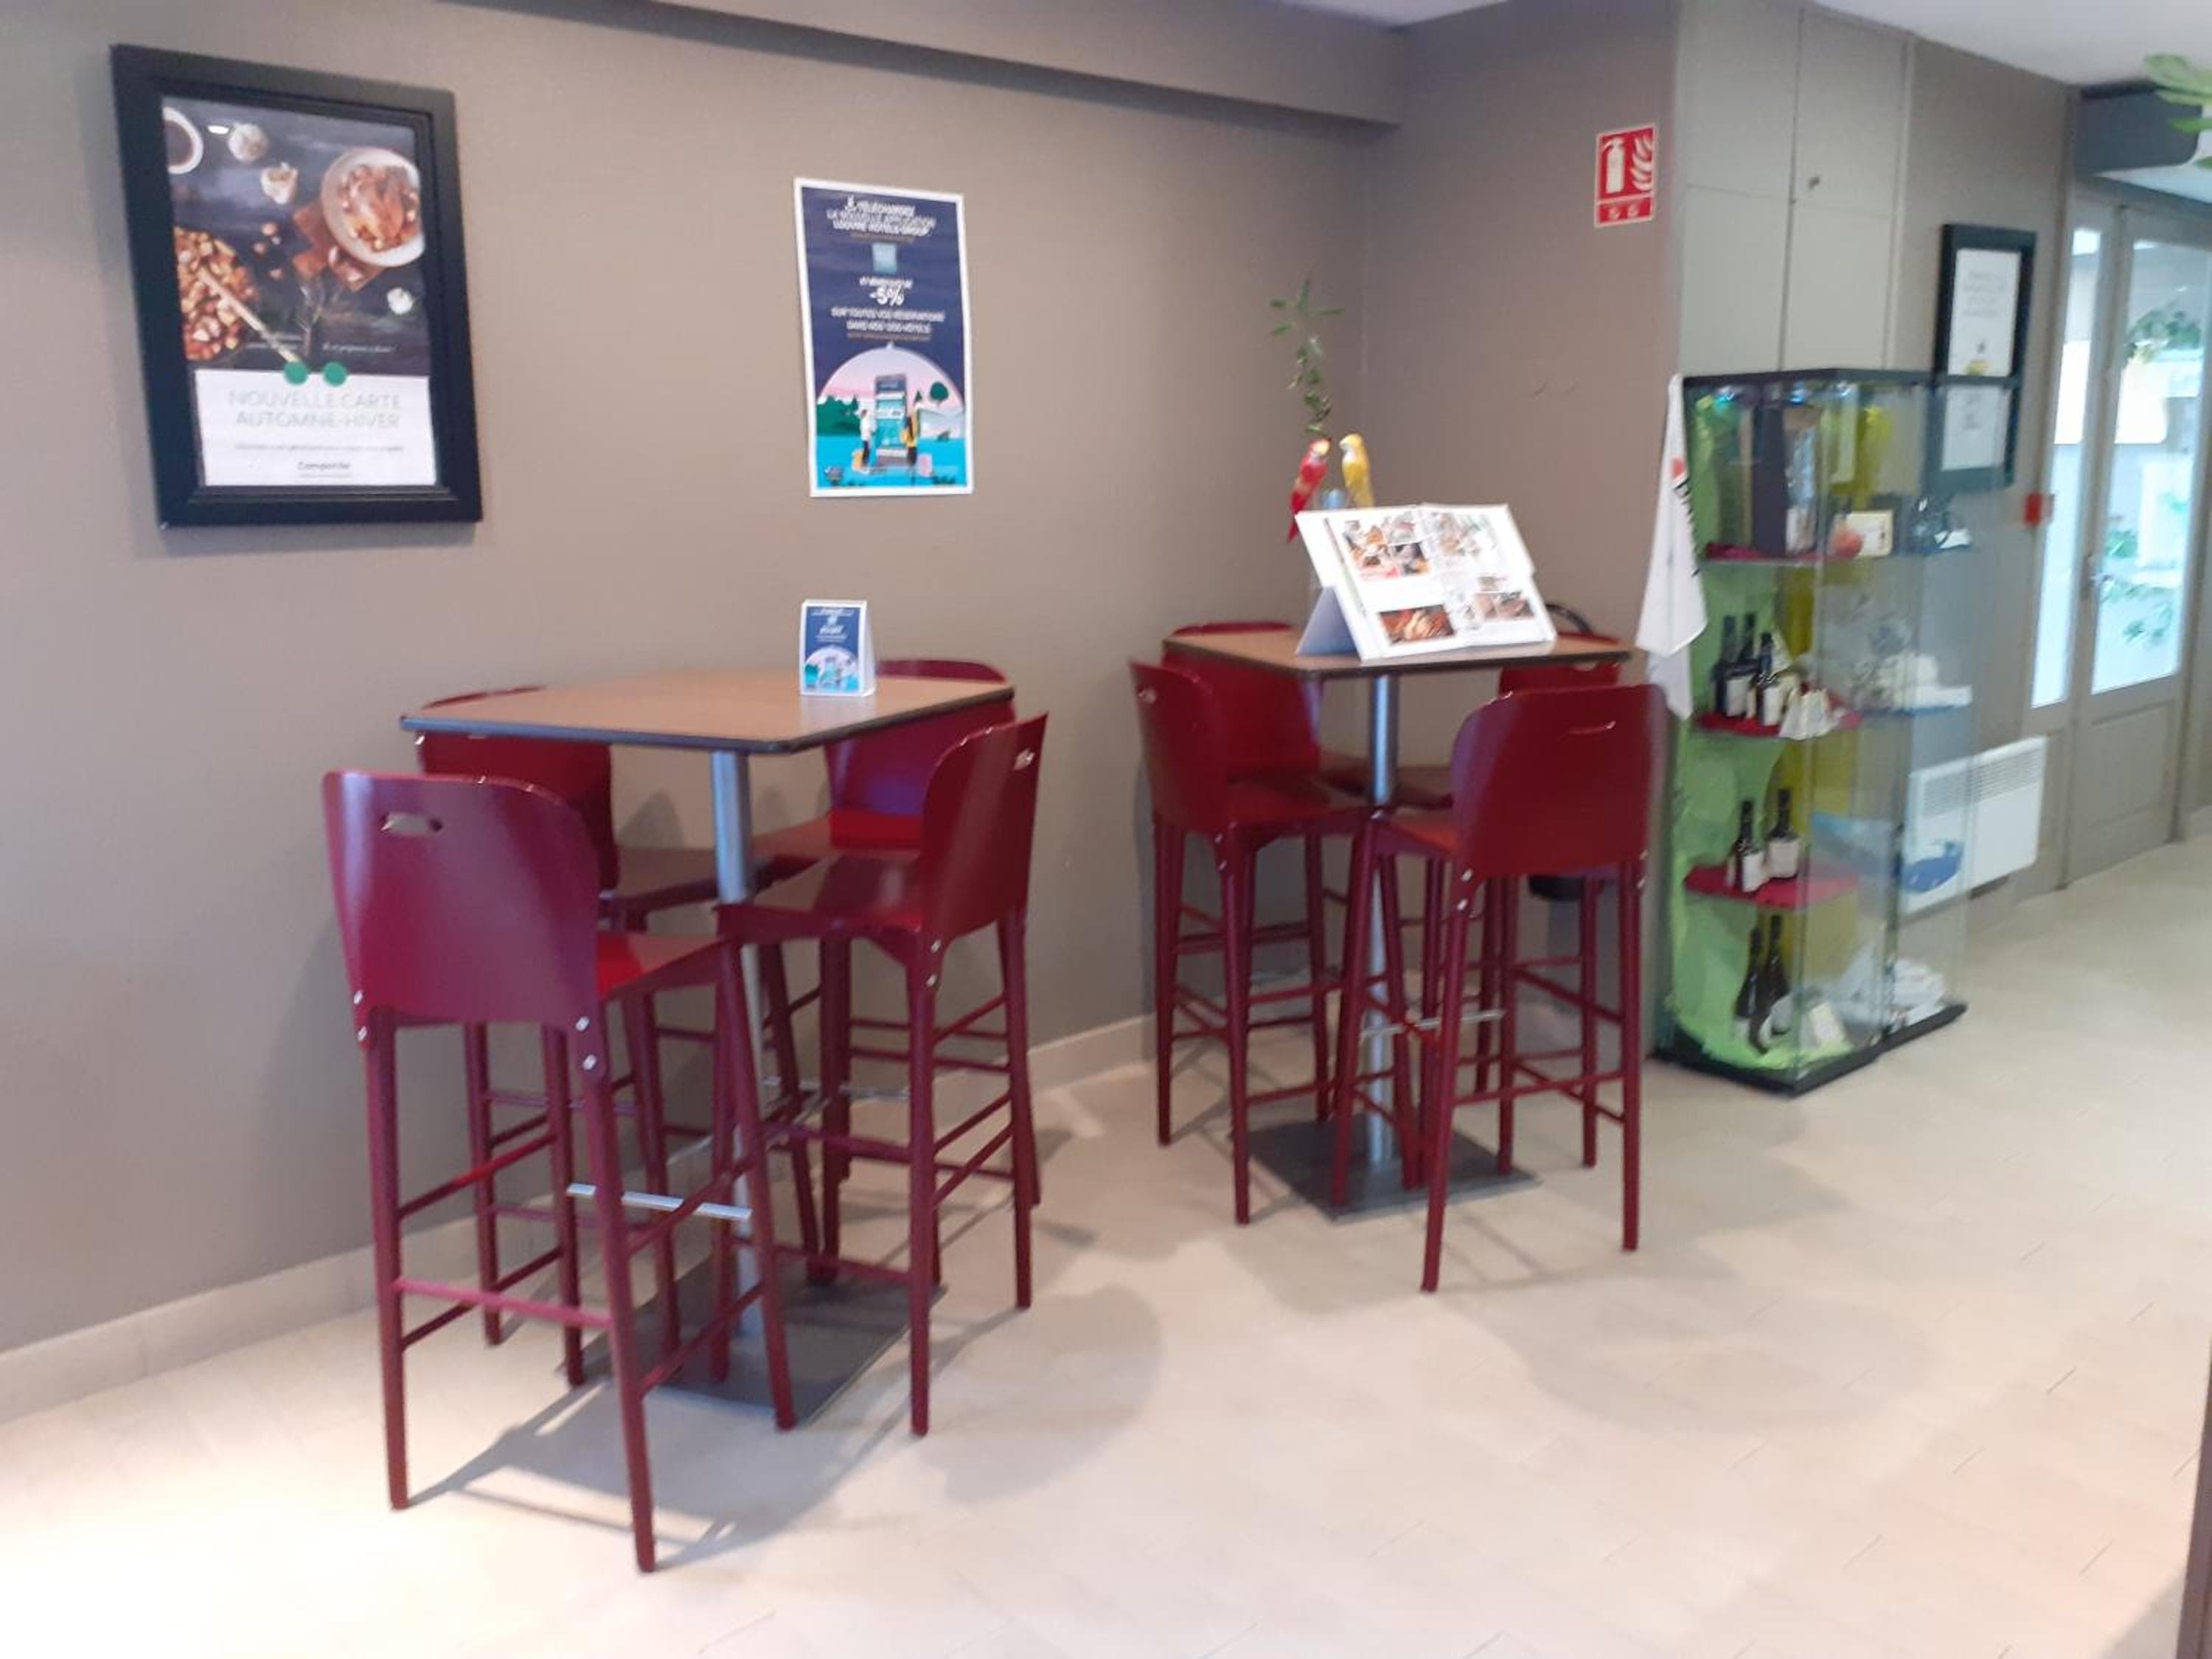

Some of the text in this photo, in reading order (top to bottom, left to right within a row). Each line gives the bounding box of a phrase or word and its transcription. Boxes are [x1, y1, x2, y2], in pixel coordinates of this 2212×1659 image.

[869, 285, 905, 307] -5%
[229, 390, 401, 409] NOUVELLE CARTE
[236, 411, 400, 428] AUTOMNE-HIVER
